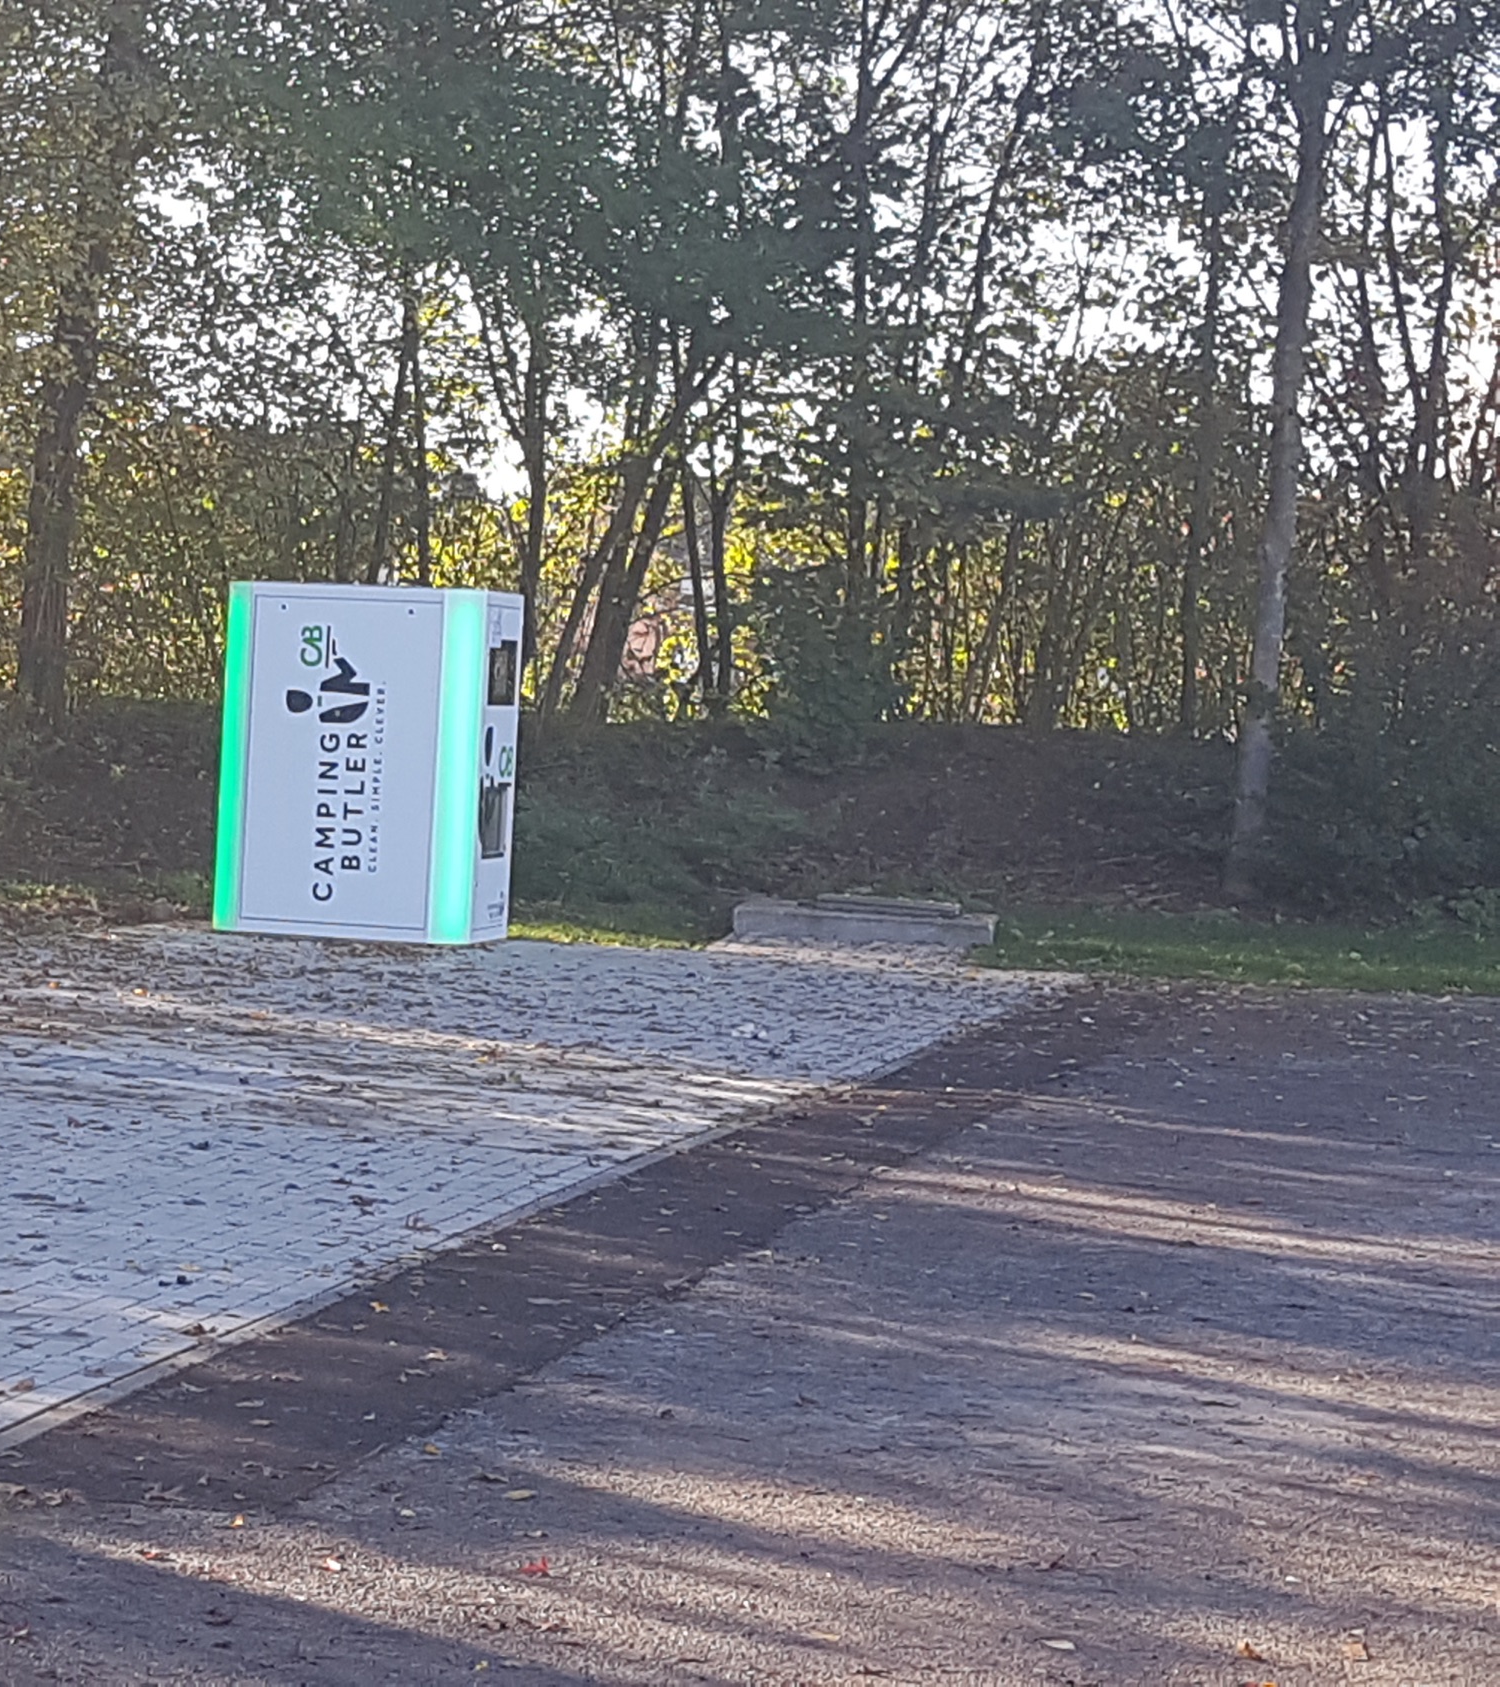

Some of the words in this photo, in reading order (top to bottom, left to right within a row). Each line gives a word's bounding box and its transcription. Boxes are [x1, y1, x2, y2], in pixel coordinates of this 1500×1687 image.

[375, 681, 387, 744] CLEVER.
[312, 732, 340, 901] CAMPING
[340, 732, 369, 871] BUTLER
[371, 752, 383, 811] SIMPLE.
